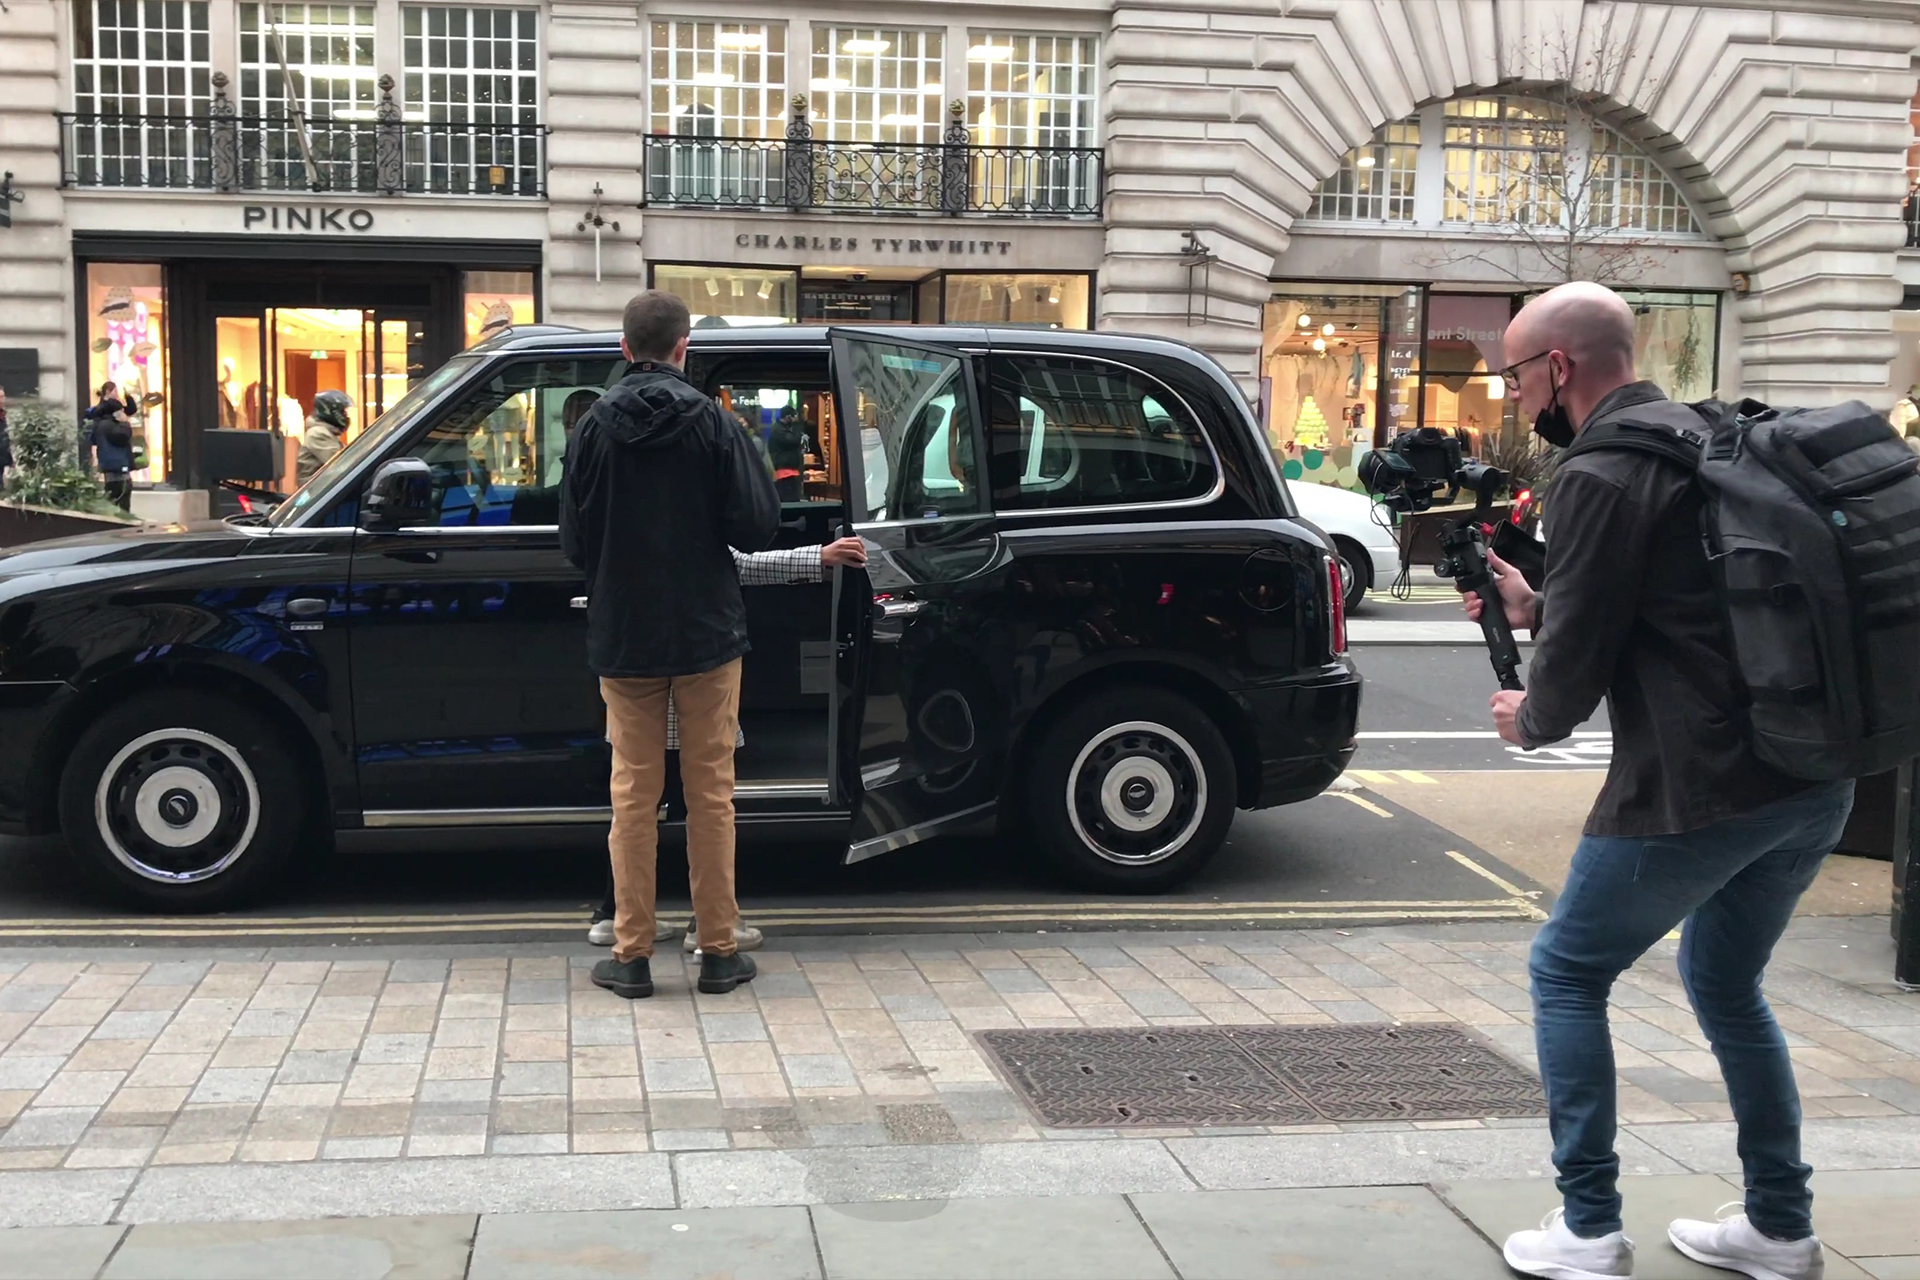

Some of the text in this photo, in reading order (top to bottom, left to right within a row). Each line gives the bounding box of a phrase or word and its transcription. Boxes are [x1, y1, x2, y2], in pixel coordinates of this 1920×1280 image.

[244, 206, 374, 230] PINKO
[735, 234, 1012, 256] CHARLES TYRWHITT
[1456, 326, 1502, 341] Street
